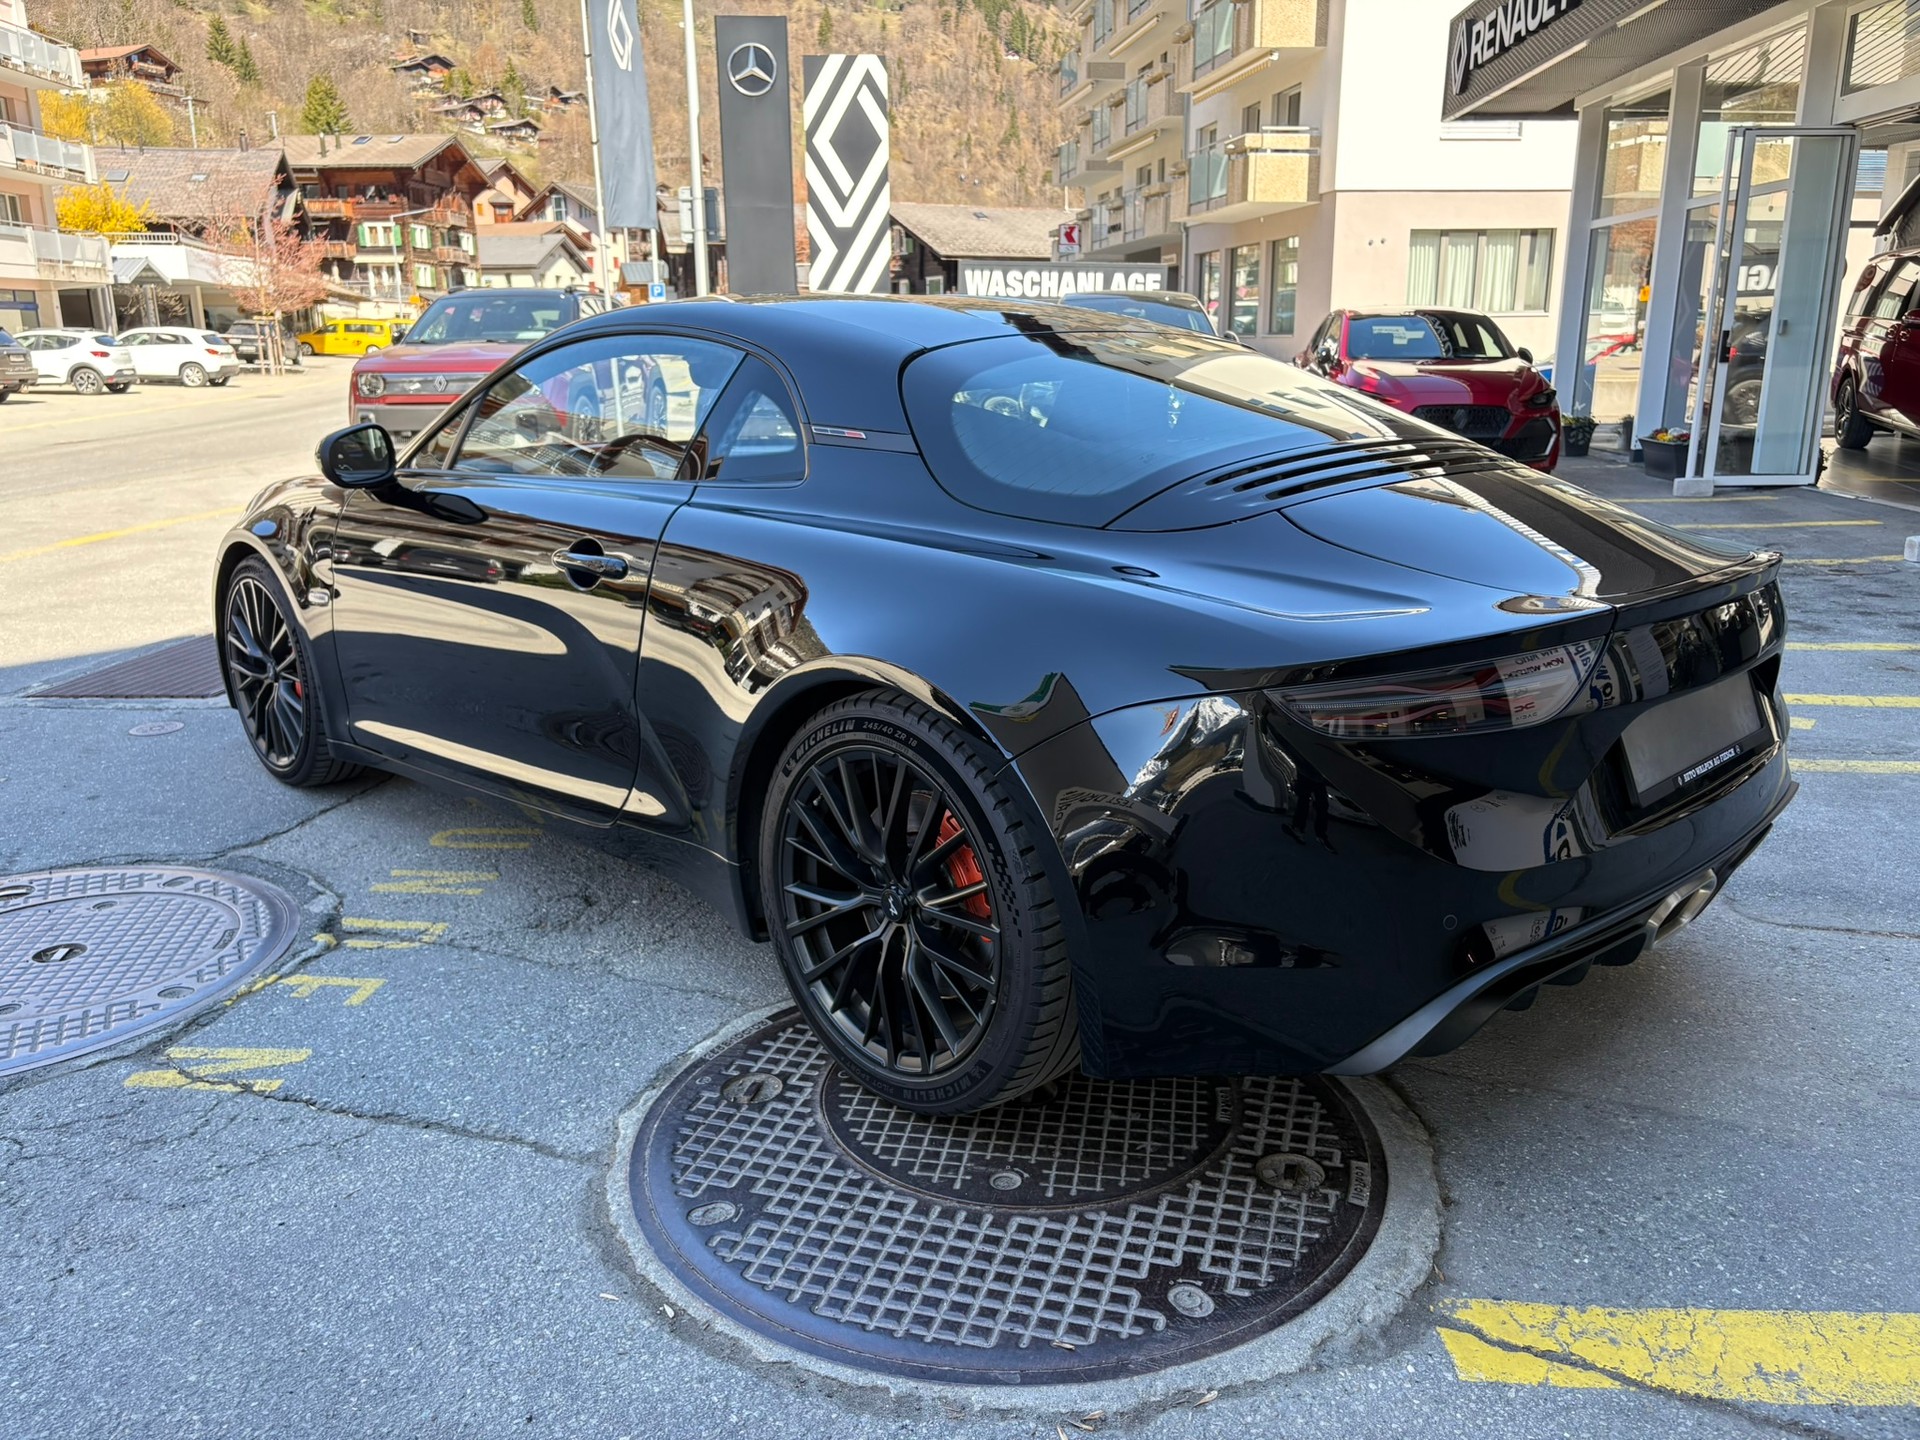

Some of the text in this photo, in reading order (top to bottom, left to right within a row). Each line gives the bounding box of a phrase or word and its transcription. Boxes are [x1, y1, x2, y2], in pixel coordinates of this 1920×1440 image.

[1469, 0, 1567, 70] RENAUL
[653, 286, 661, 296] P
[964, 269, 1161, 297] WASCHANLAGE
[796, 719, 856, 760] MICHELIN
[862, 721, 893, 735] 245/40
[894, 730, 908, 741] ZR
[908, 737, 918, 748] 18
[903, 1075, 973, 1100] MICHELIN
